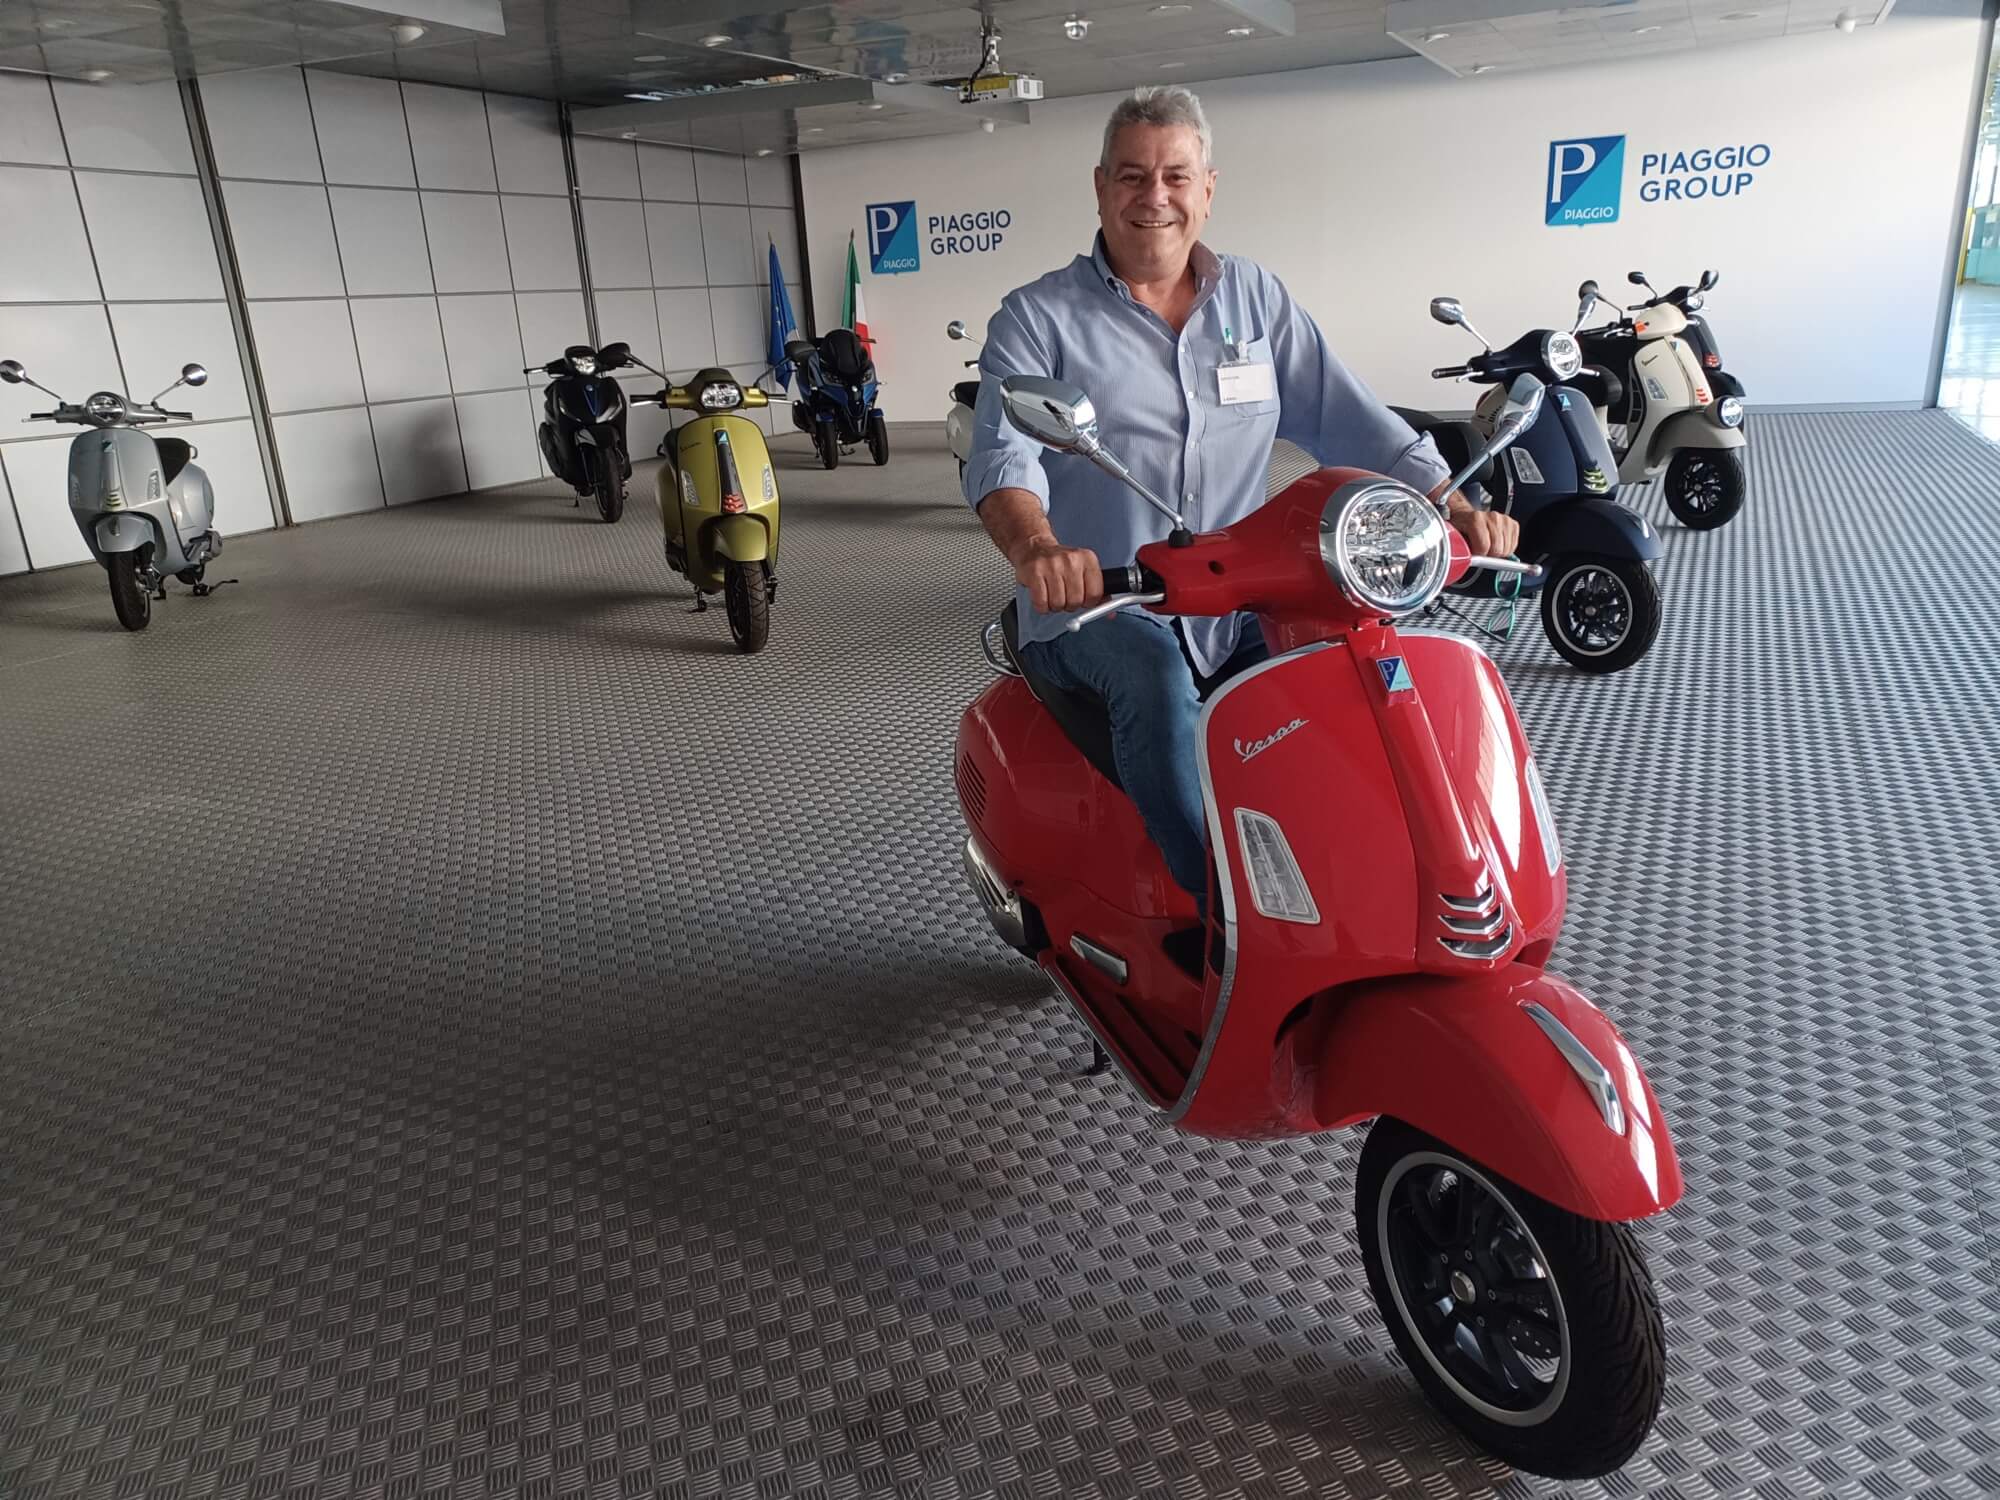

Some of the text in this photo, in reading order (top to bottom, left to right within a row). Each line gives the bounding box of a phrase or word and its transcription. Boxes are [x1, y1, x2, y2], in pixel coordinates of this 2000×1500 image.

[1551, 143, 1596, 203] P
[1641, 144, 1771, 176] PIAGGIO
[1639, 173, 1753, 202] GROUP
[928, 210, 1011, 234] PIAGGIO
[1564, 206, 1614, 220] PIAGGIO
[869, 207, 898, 255] P
[930, 233, 1003, 255] GROUP
[883, 258, 917, 269] PIAGGIO
[1233, 717, 1310, 764] Vespa
